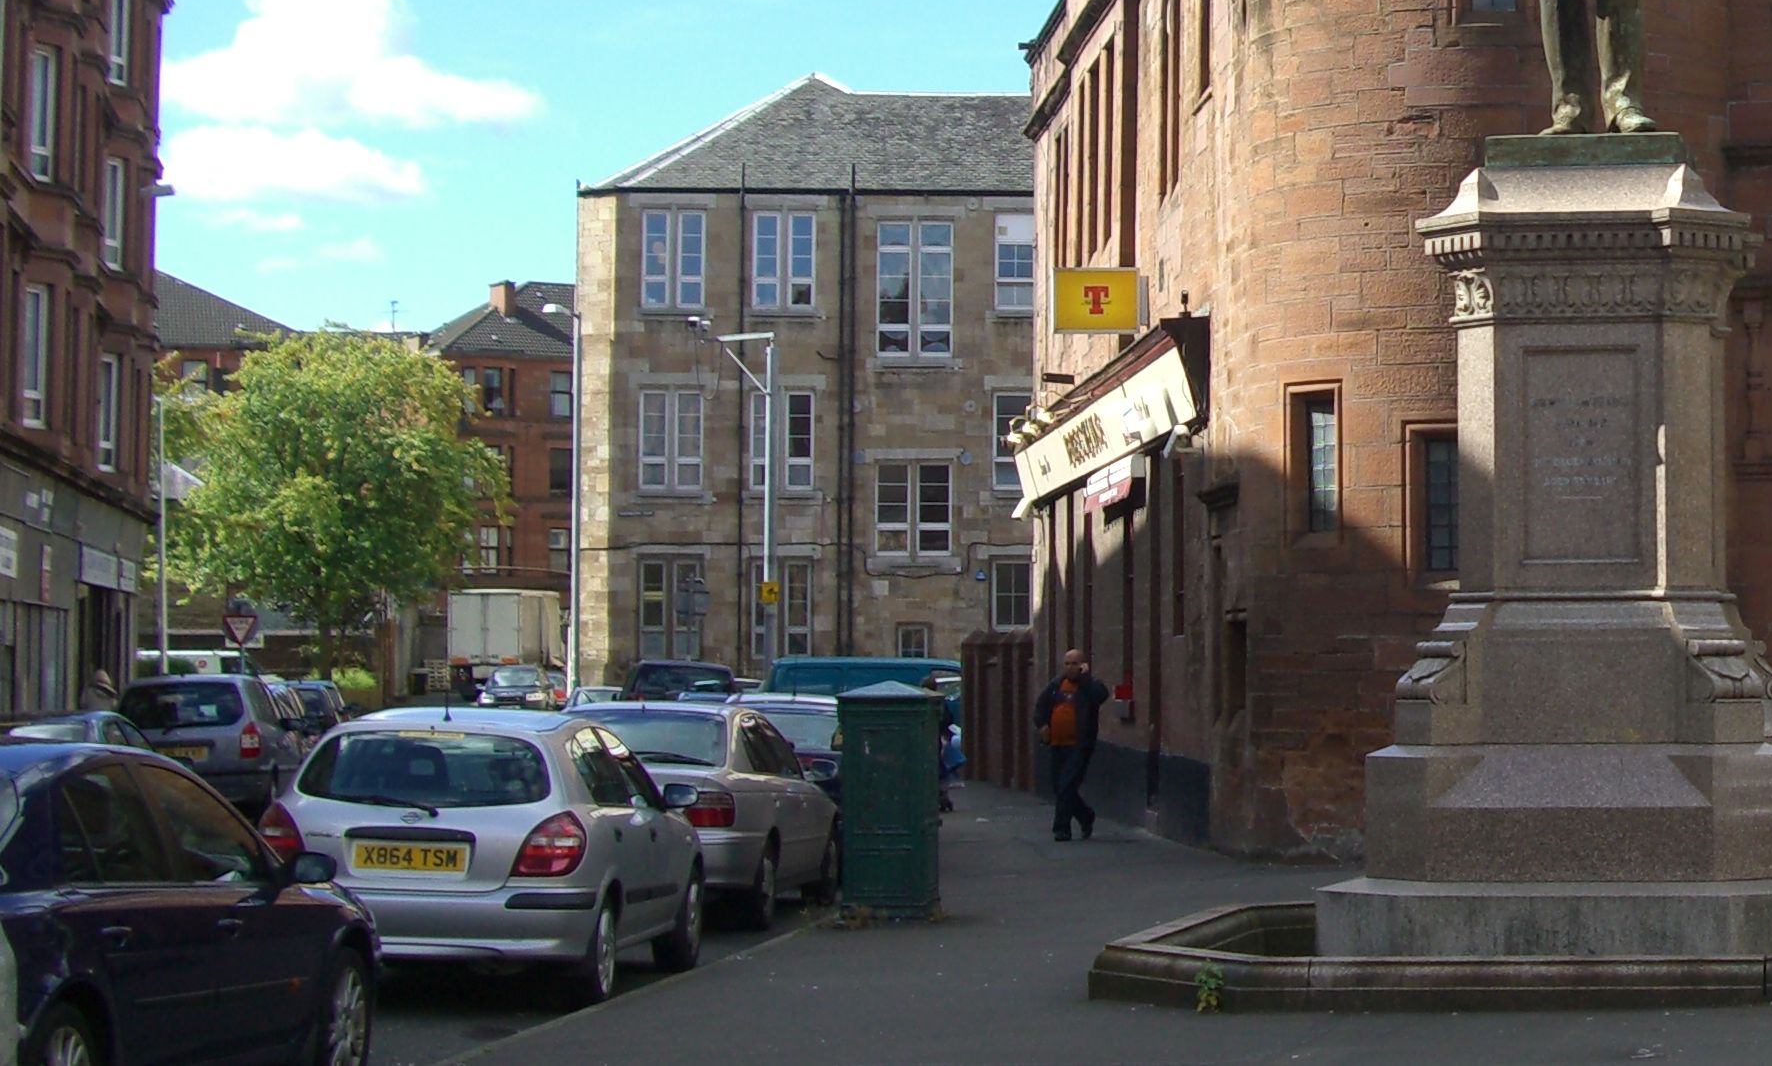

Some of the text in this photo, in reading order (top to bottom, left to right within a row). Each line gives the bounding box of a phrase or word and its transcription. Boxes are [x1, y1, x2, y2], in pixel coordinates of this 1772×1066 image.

[1083, 285, 1110, 315] T
[363, 846, 458, 867] X864 TSM
